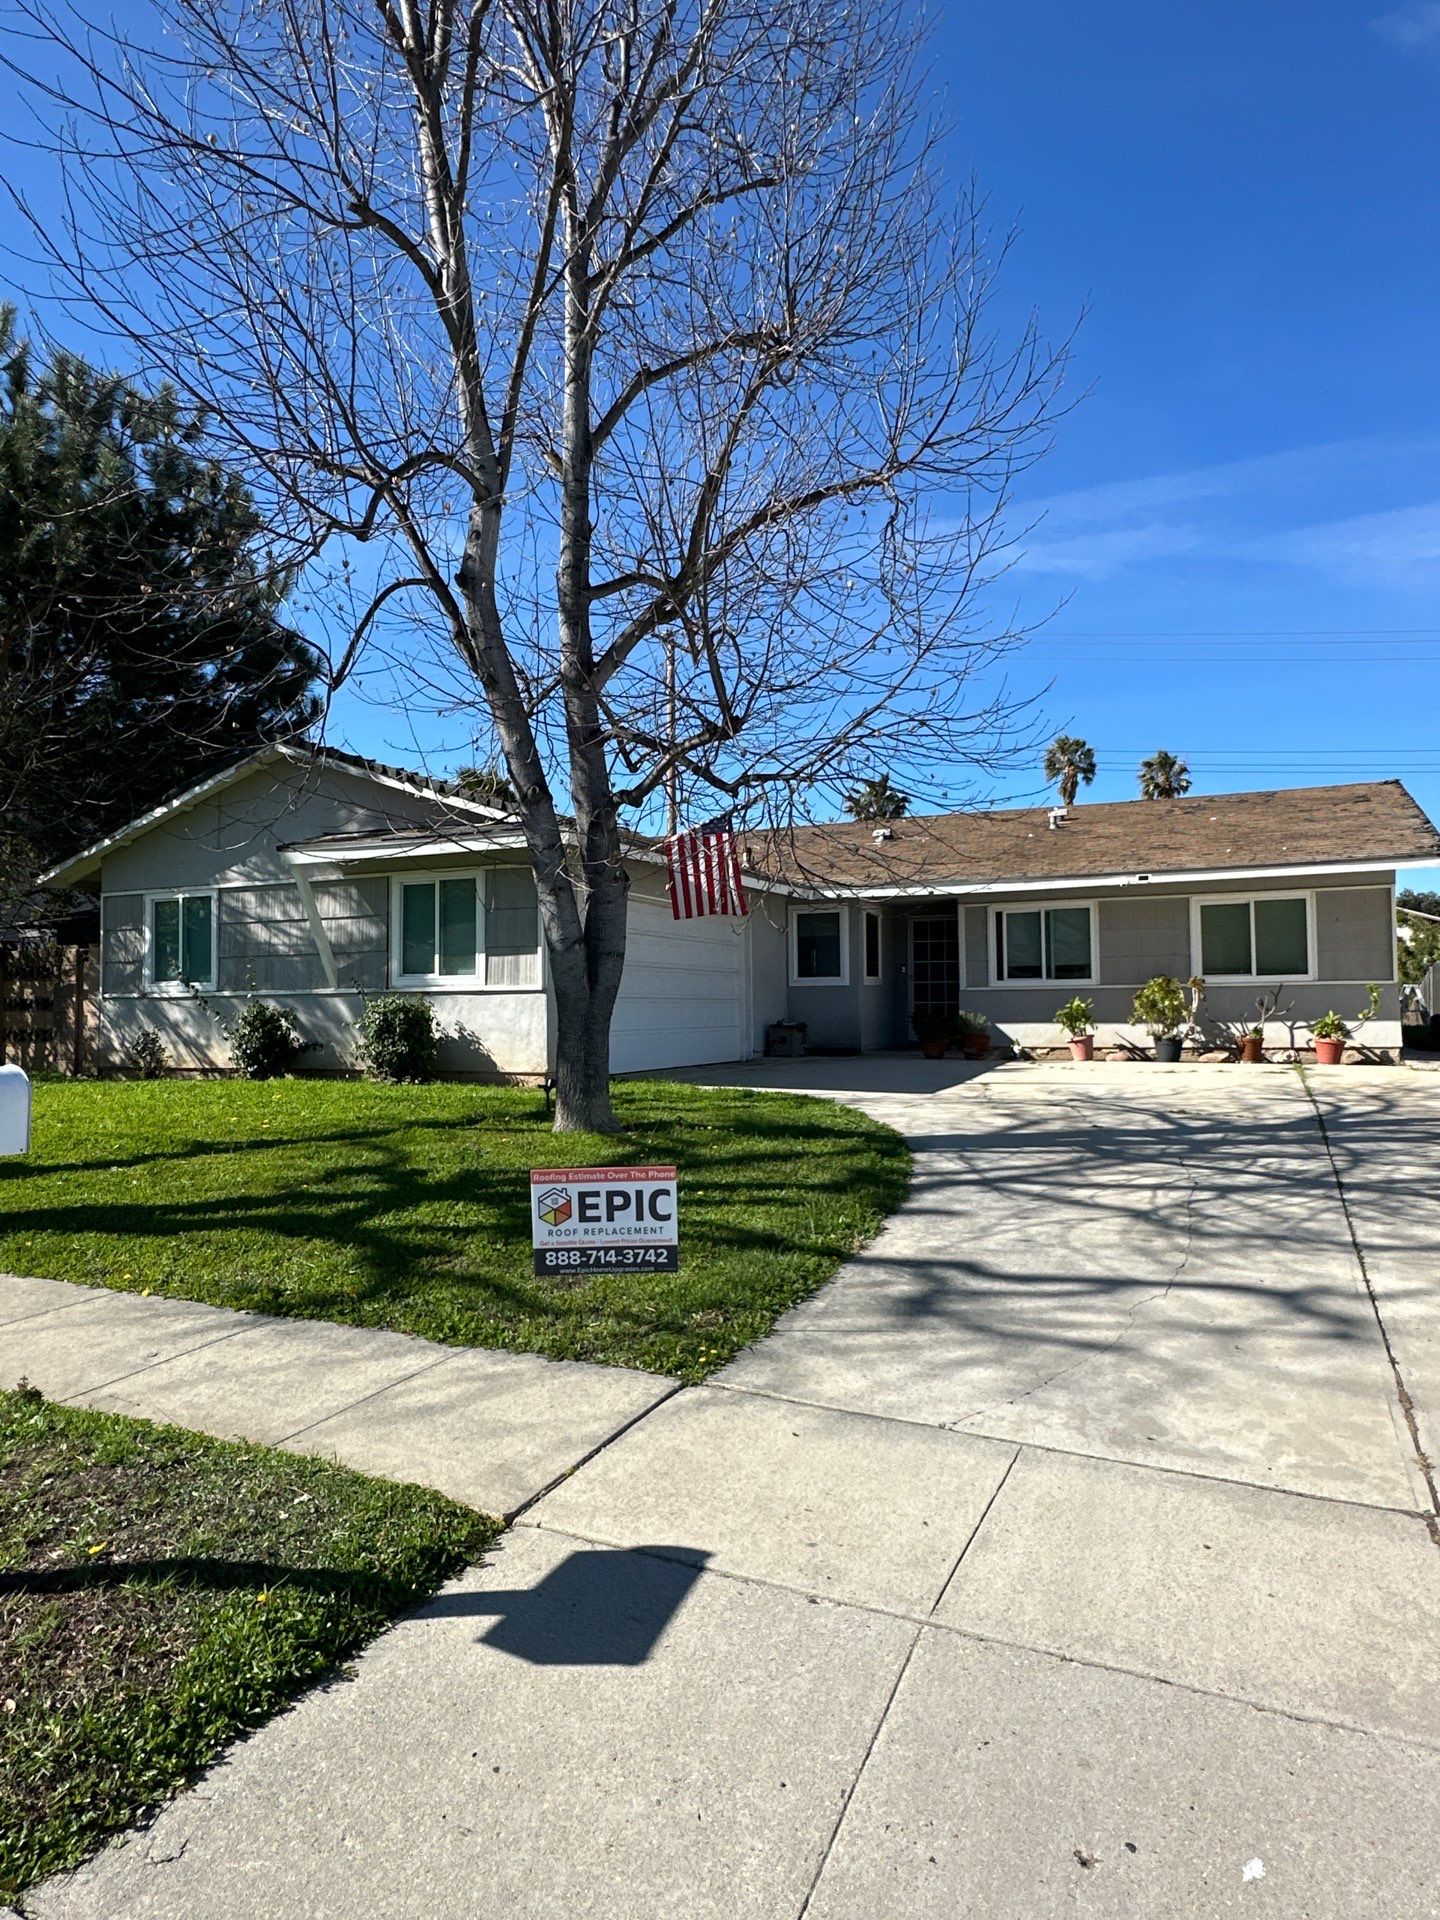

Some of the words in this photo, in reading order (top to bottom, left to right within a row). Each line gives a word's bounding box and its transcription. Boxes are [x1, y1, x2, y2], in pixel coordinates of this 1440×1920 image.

[533, 1173, 567, 1182] Roofing
[568, 1172, 605, 1180] Estimate
[607, 1171, 628, 1179] Over
[630, 1171, 647, 1179] The
[648, 1170, 676, 1178] Phone
[577, 1188, 672, 1222] EPIC
[547, 1228, 579, 1237] ROOF
[583, 1226, 664, 1236] REPLACEMENT
[545, 1248, 669, 1265] 888-714-3742
